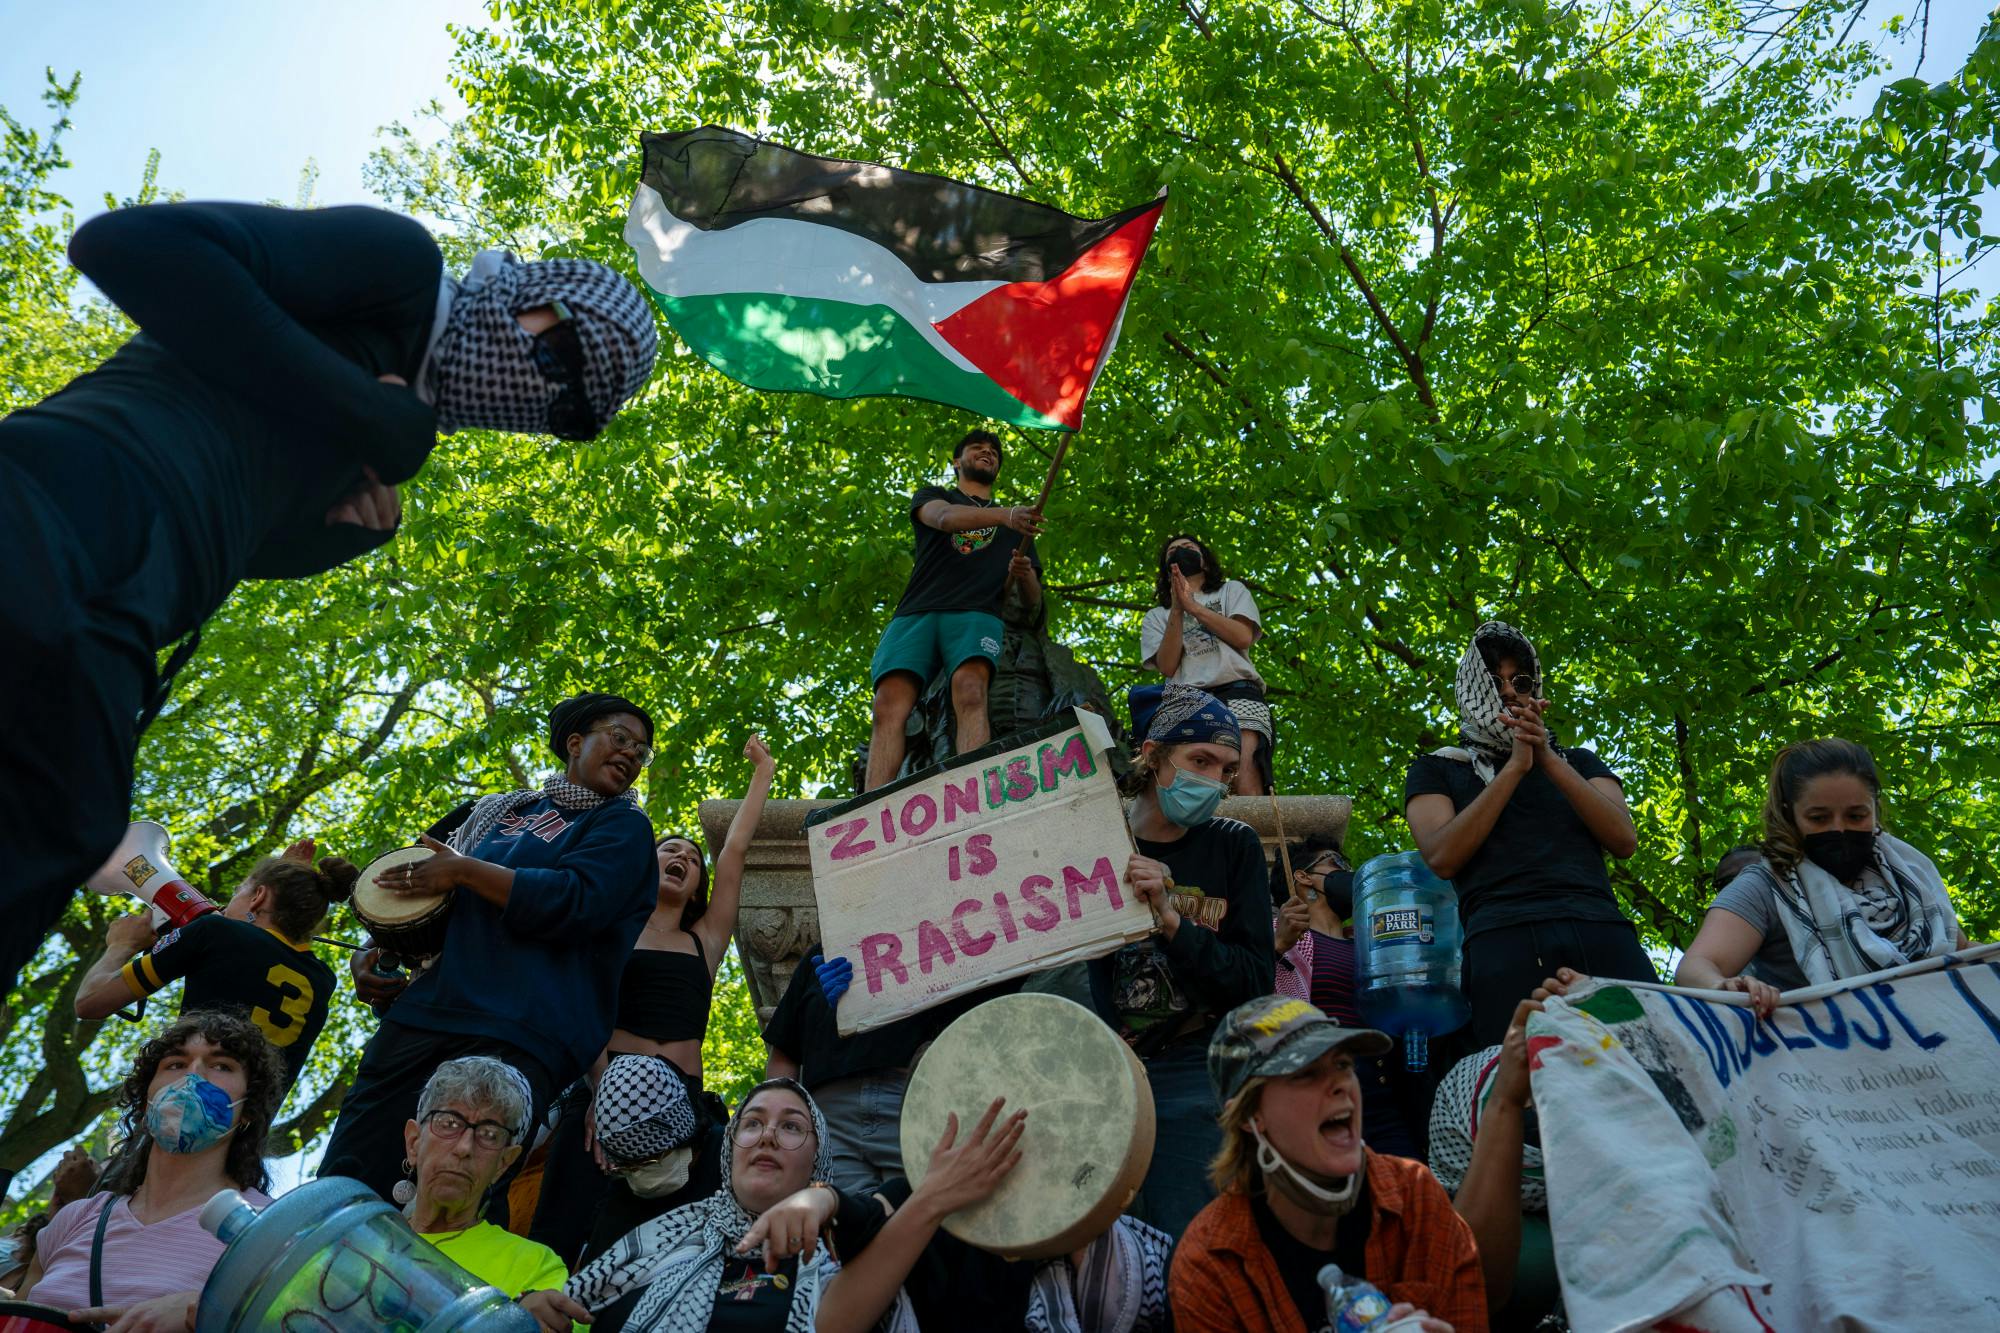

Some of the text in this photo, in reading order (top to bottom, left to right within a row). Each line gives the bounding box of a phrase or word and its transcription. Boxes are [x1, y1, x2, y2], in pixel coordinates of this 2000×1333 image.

[824, 732, 1098, 861] ZIONISM
[948, 833, 998, 881] IS
[860, 856, 1125, 994] RACISM
[1386, 912, 1416, 922] DEER
[1386, 920, 1417, 931] PARK
[251, 963, 314, 1047] 3
